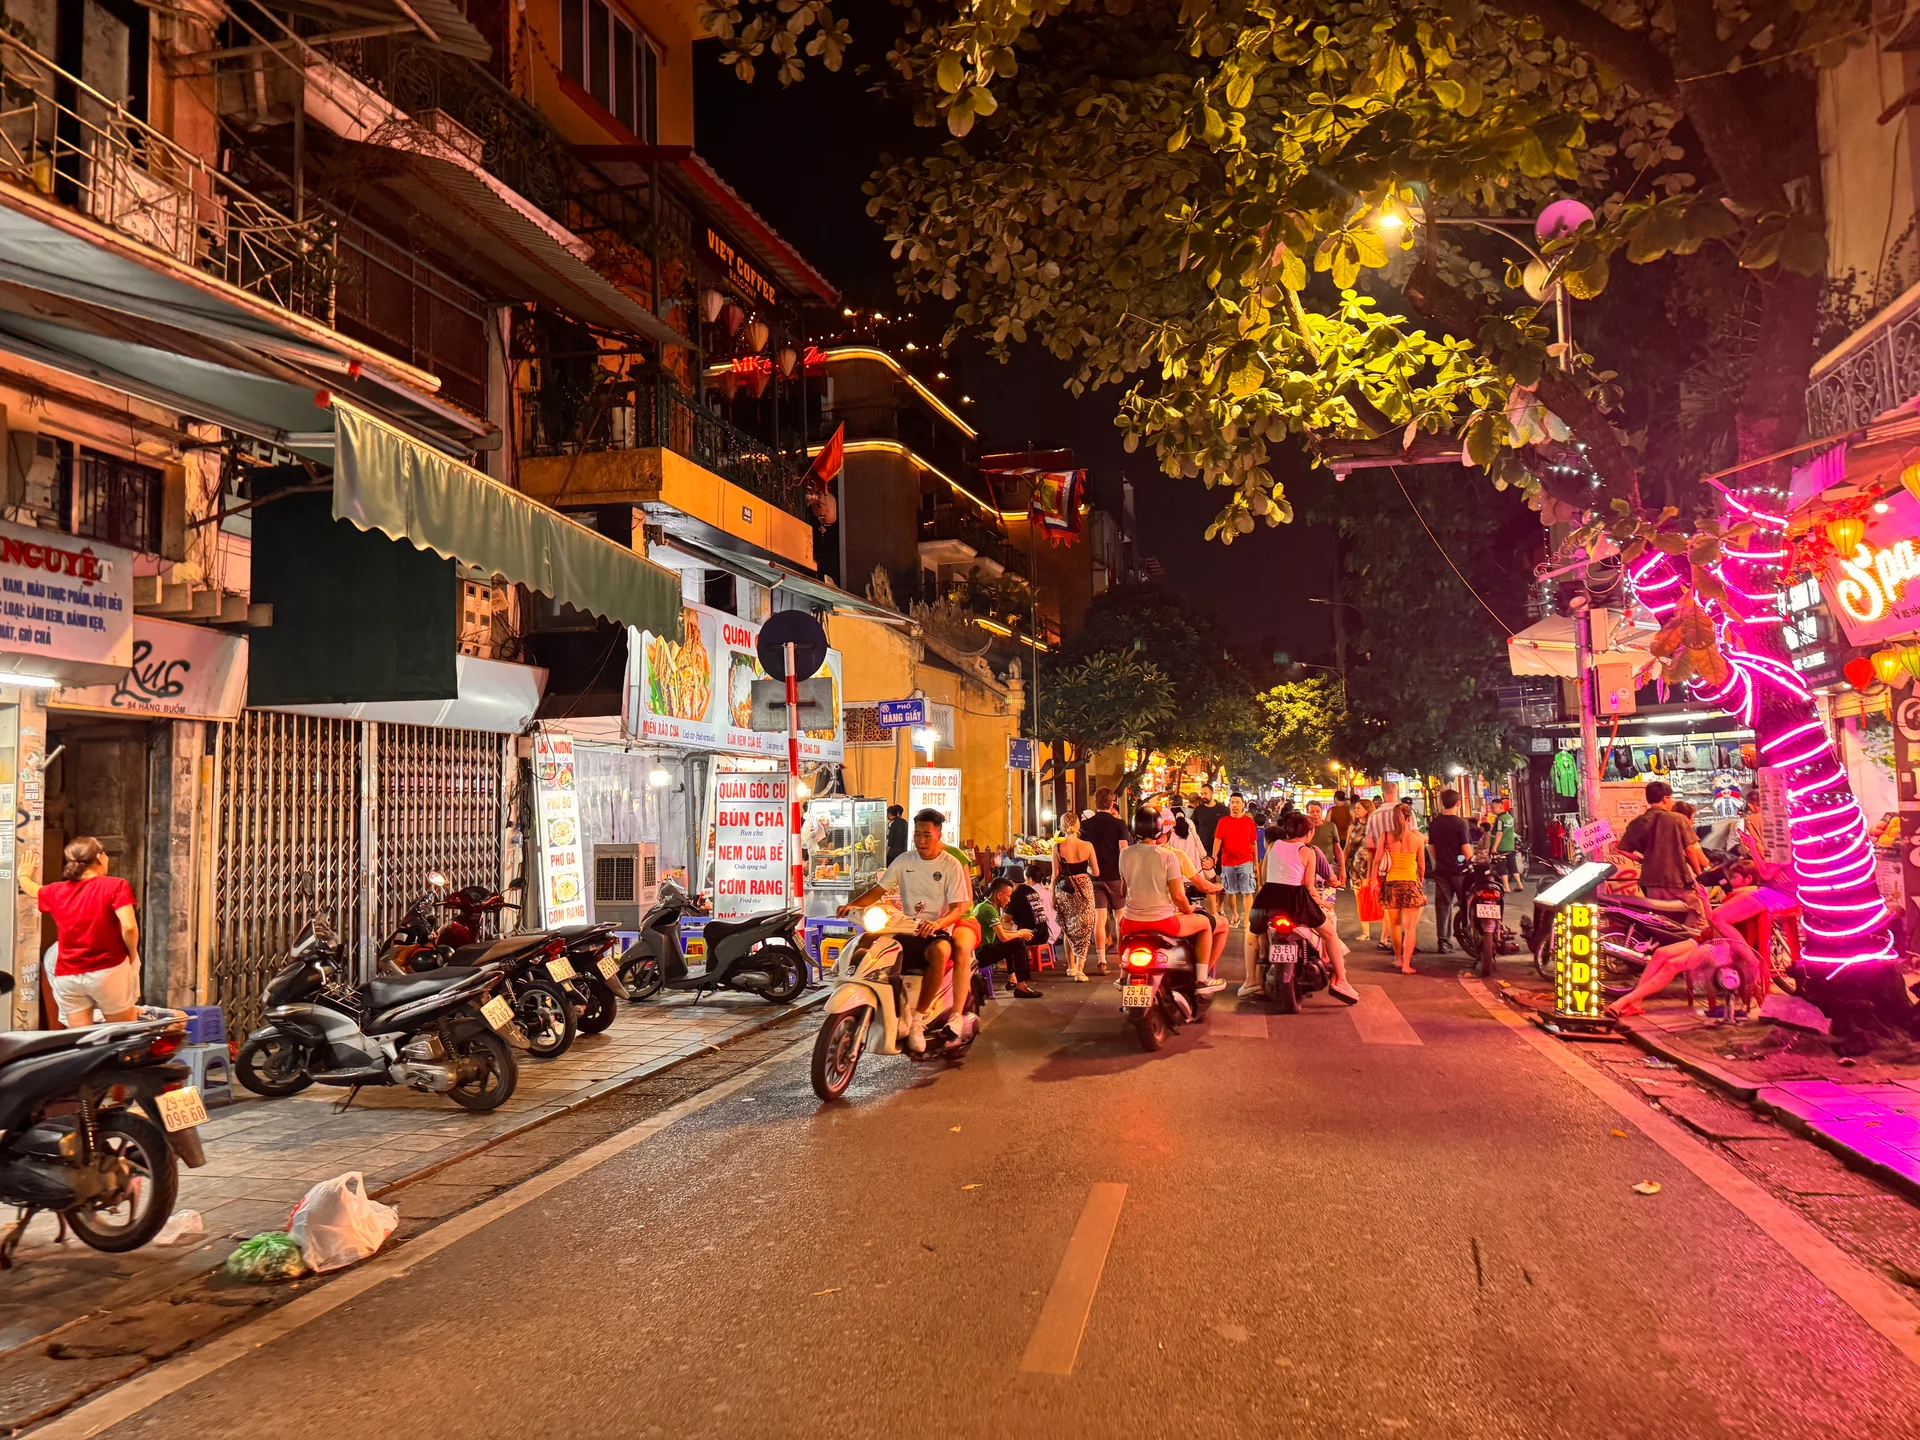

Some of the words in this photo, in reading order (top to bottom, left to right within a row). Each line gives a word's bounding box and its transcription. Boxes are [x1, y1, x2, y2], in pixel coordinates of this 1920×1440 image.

[707, 228, 735, 267] VIET
[736, 256, 776, 306] COFFEE
[729, 268, 757, 300] BALCONY
[0, 536, 114, 587] NGUYỆT
[723, 623, 752, 649] QUÁN
[896, 702, 912, 710] PHỐ
[882, 711, 904, 724] HÀNG
[719, 779, 747, 800] QUÁN
[749, 777, 769, 799] GỐC
[772, 780, 787, 799] CŨ
[922, 792, 946, 805] BITTET
[719, 808, 750, 827] BÚN
[755, 807, 785, 827] CHẢ
[718, 844, 743, 861] NEM
[746, 845, 767, 861] CUA
[718, 878, 746, 895] CƠM
[750, 879, 783, 896] RANG
[1572, 905, 1591, 1013] BODY
[1126, 986, 1149, 996] 29-AC
[165, 1105, 206, 1128] 096.60
